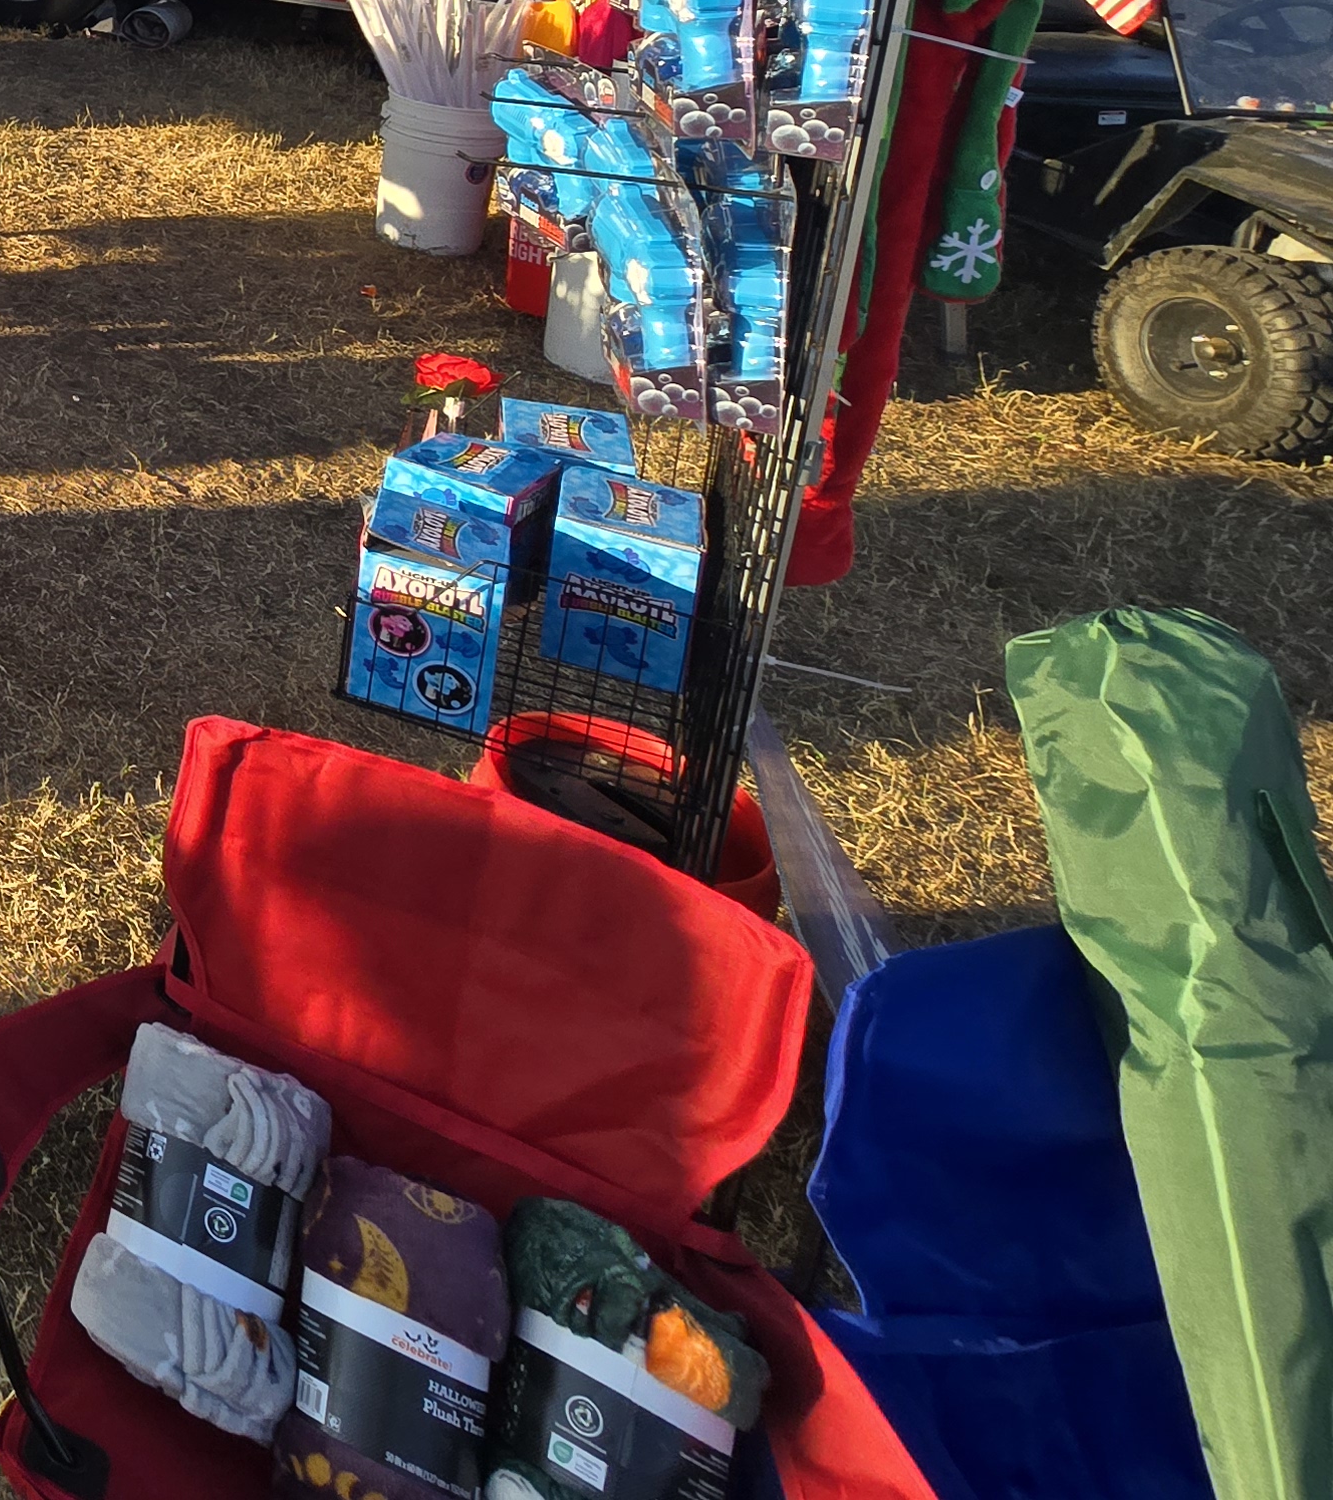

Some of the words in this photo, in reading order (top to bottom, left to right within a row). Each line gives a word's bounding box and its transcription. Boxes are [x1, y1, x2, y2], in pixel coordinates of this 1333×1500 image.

[375, 566, 485, 617] AXOLOTL
[391, 1333, 453, 1373] celebrate!
[423, 1397, 461, 1429] Plush
